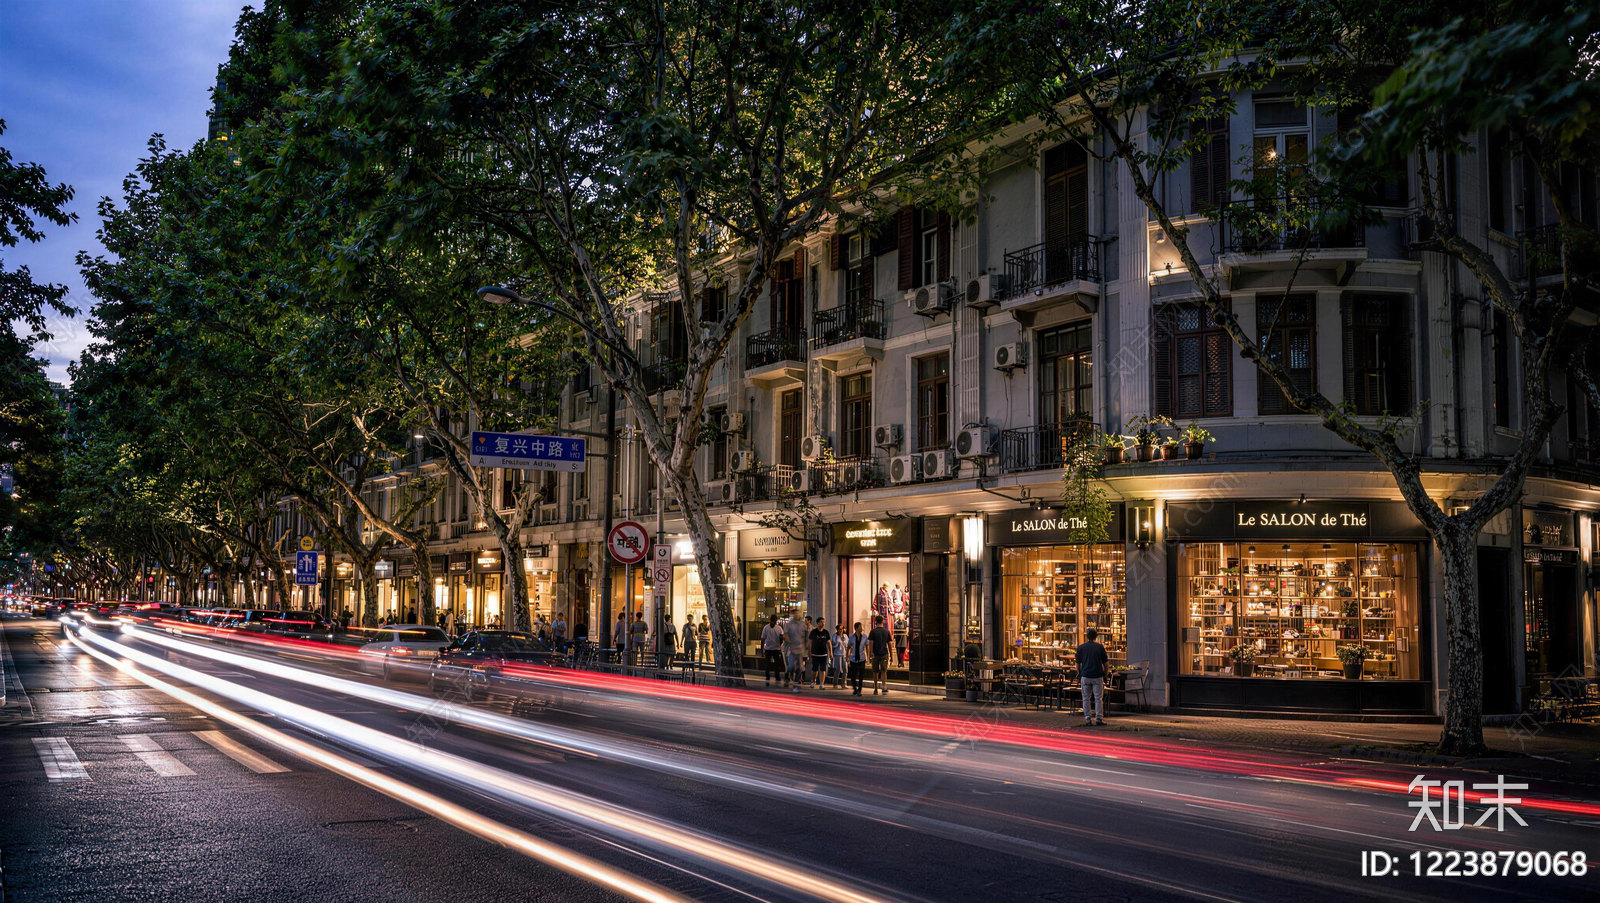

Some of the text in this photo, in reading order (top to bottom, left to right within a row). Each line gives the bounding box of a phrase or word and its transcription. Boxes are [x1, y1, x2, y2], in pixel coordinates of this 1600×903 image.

[494, 436, 563, 458] 复兴中路
[1011, 516, 1088, 532] Le SALON de Thé
[1238, 512, 1367, 526] Le SALON de Thé
